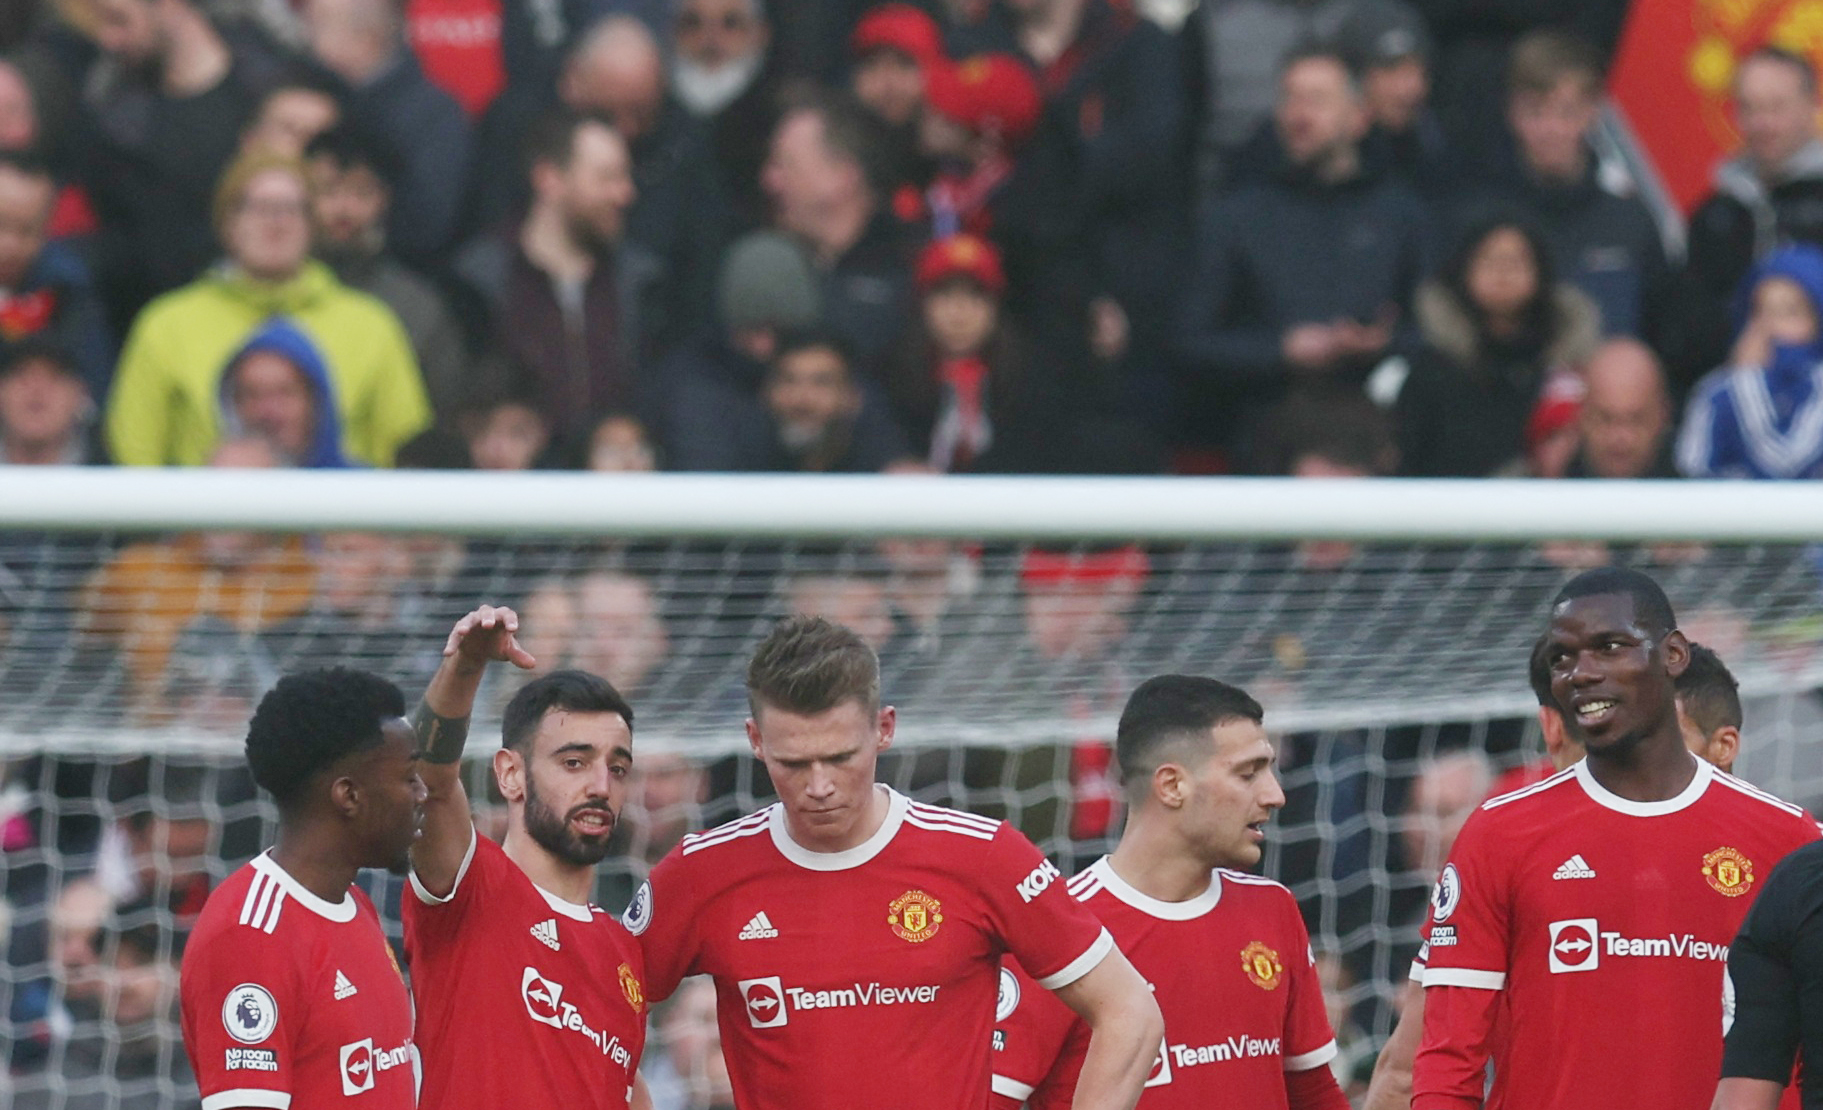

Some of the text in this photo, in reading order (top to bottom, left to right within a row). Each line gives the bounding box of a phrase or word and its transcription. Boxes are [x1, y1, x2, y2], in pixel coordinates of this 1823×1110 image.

[1552, 869, 1596, 880] adidas
[739, 928, 778, 940] adidas
[786, 982, 940, 1010] TeamViewer
[226, 1048, 273, 1061] No room
